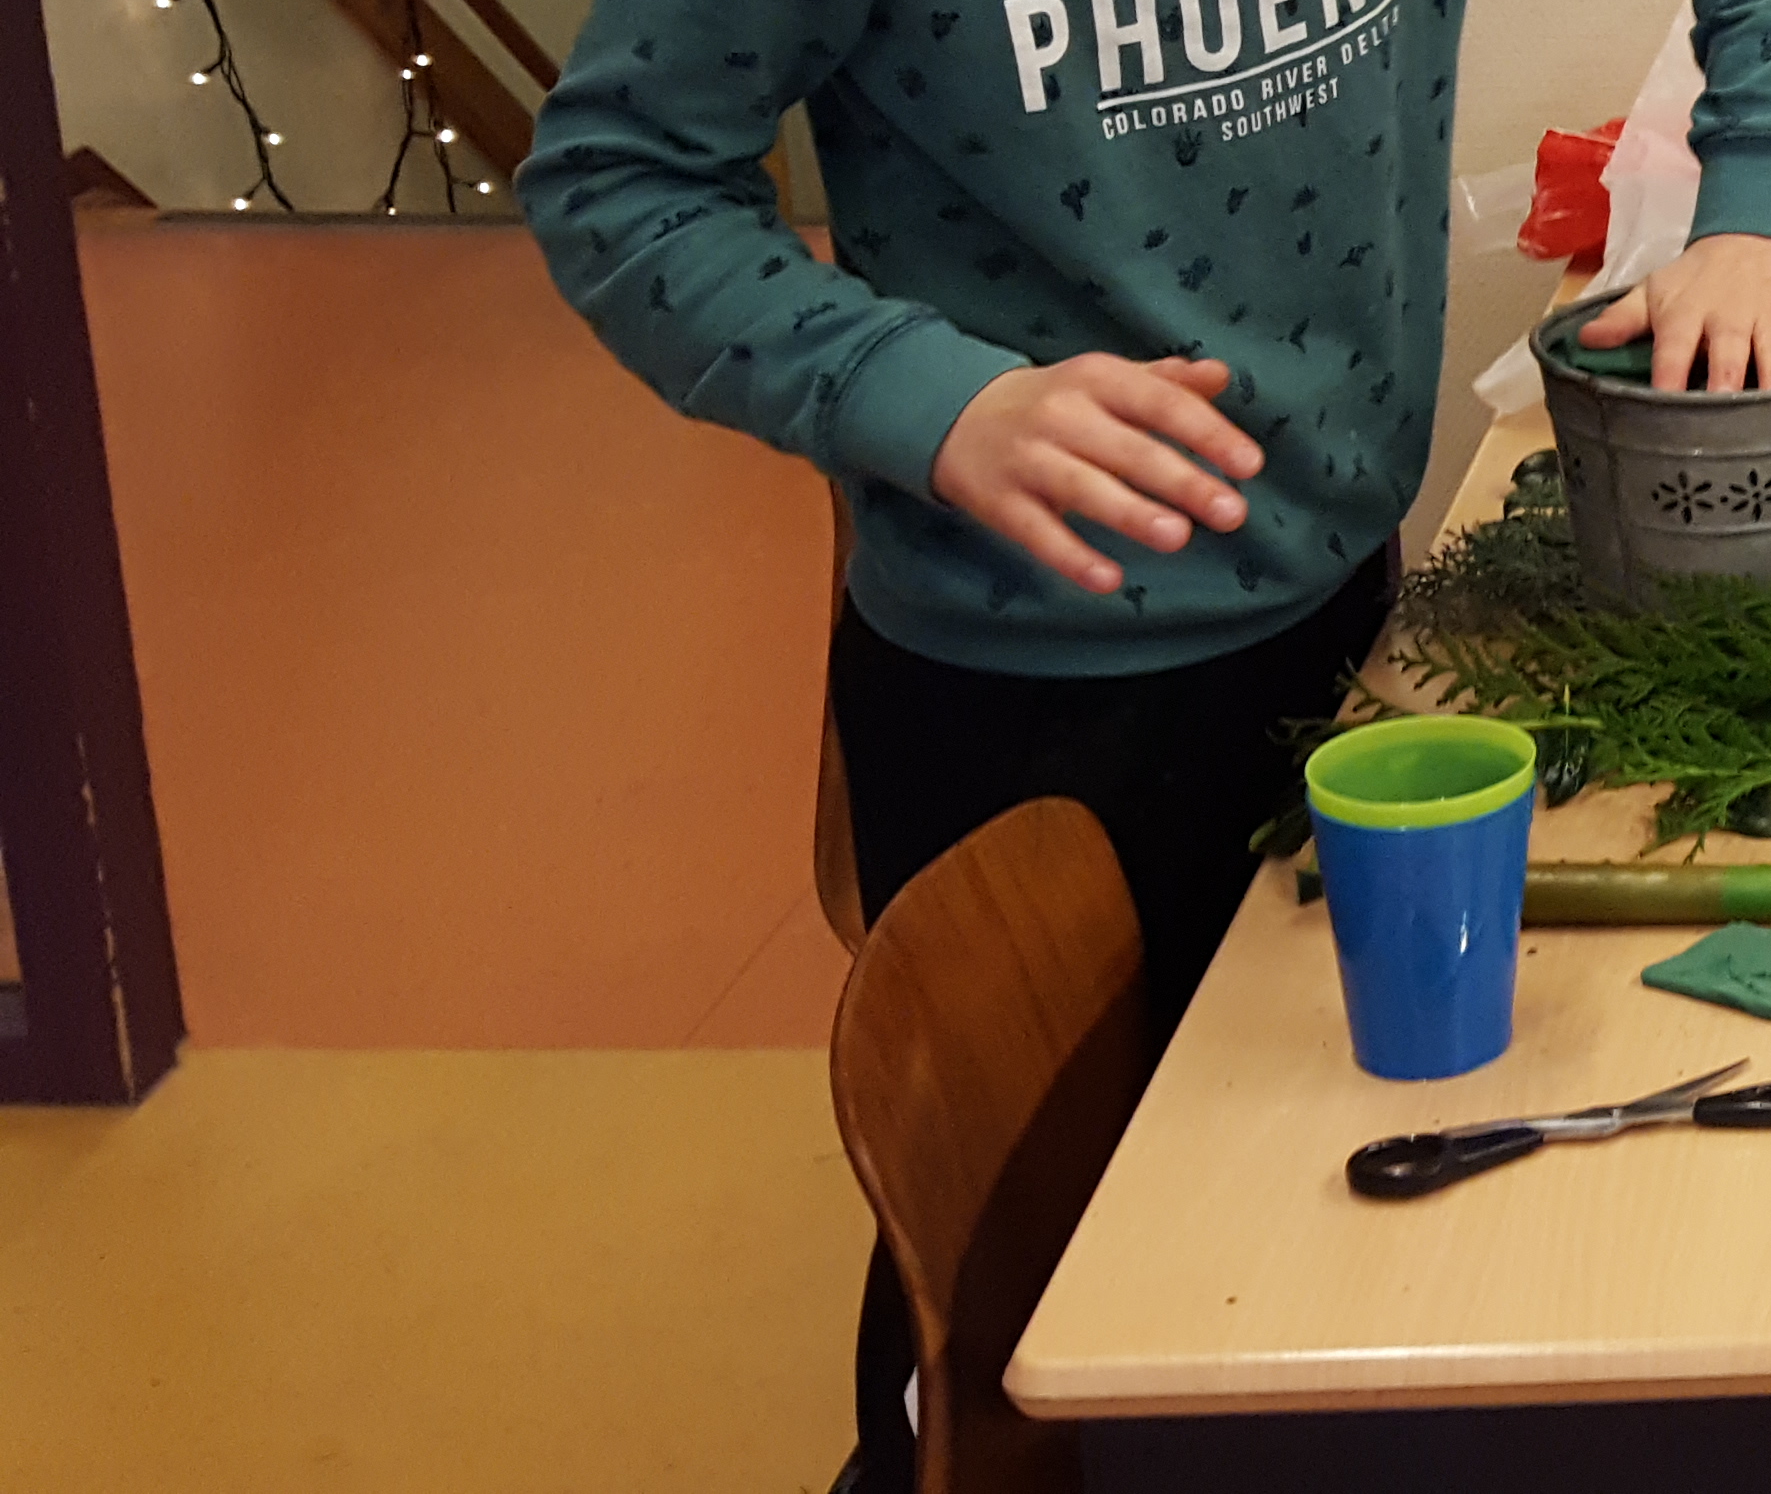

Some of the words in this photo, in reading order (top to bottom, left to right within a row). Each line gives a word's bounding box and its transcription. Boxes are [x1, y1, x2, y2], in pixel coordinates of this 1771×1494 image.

[1102, 88, 1246, 141] COLORADO
[1259, 55, 1329, 102] RIVER
[1220, 77, 1341, 142] SOUTHWEST
